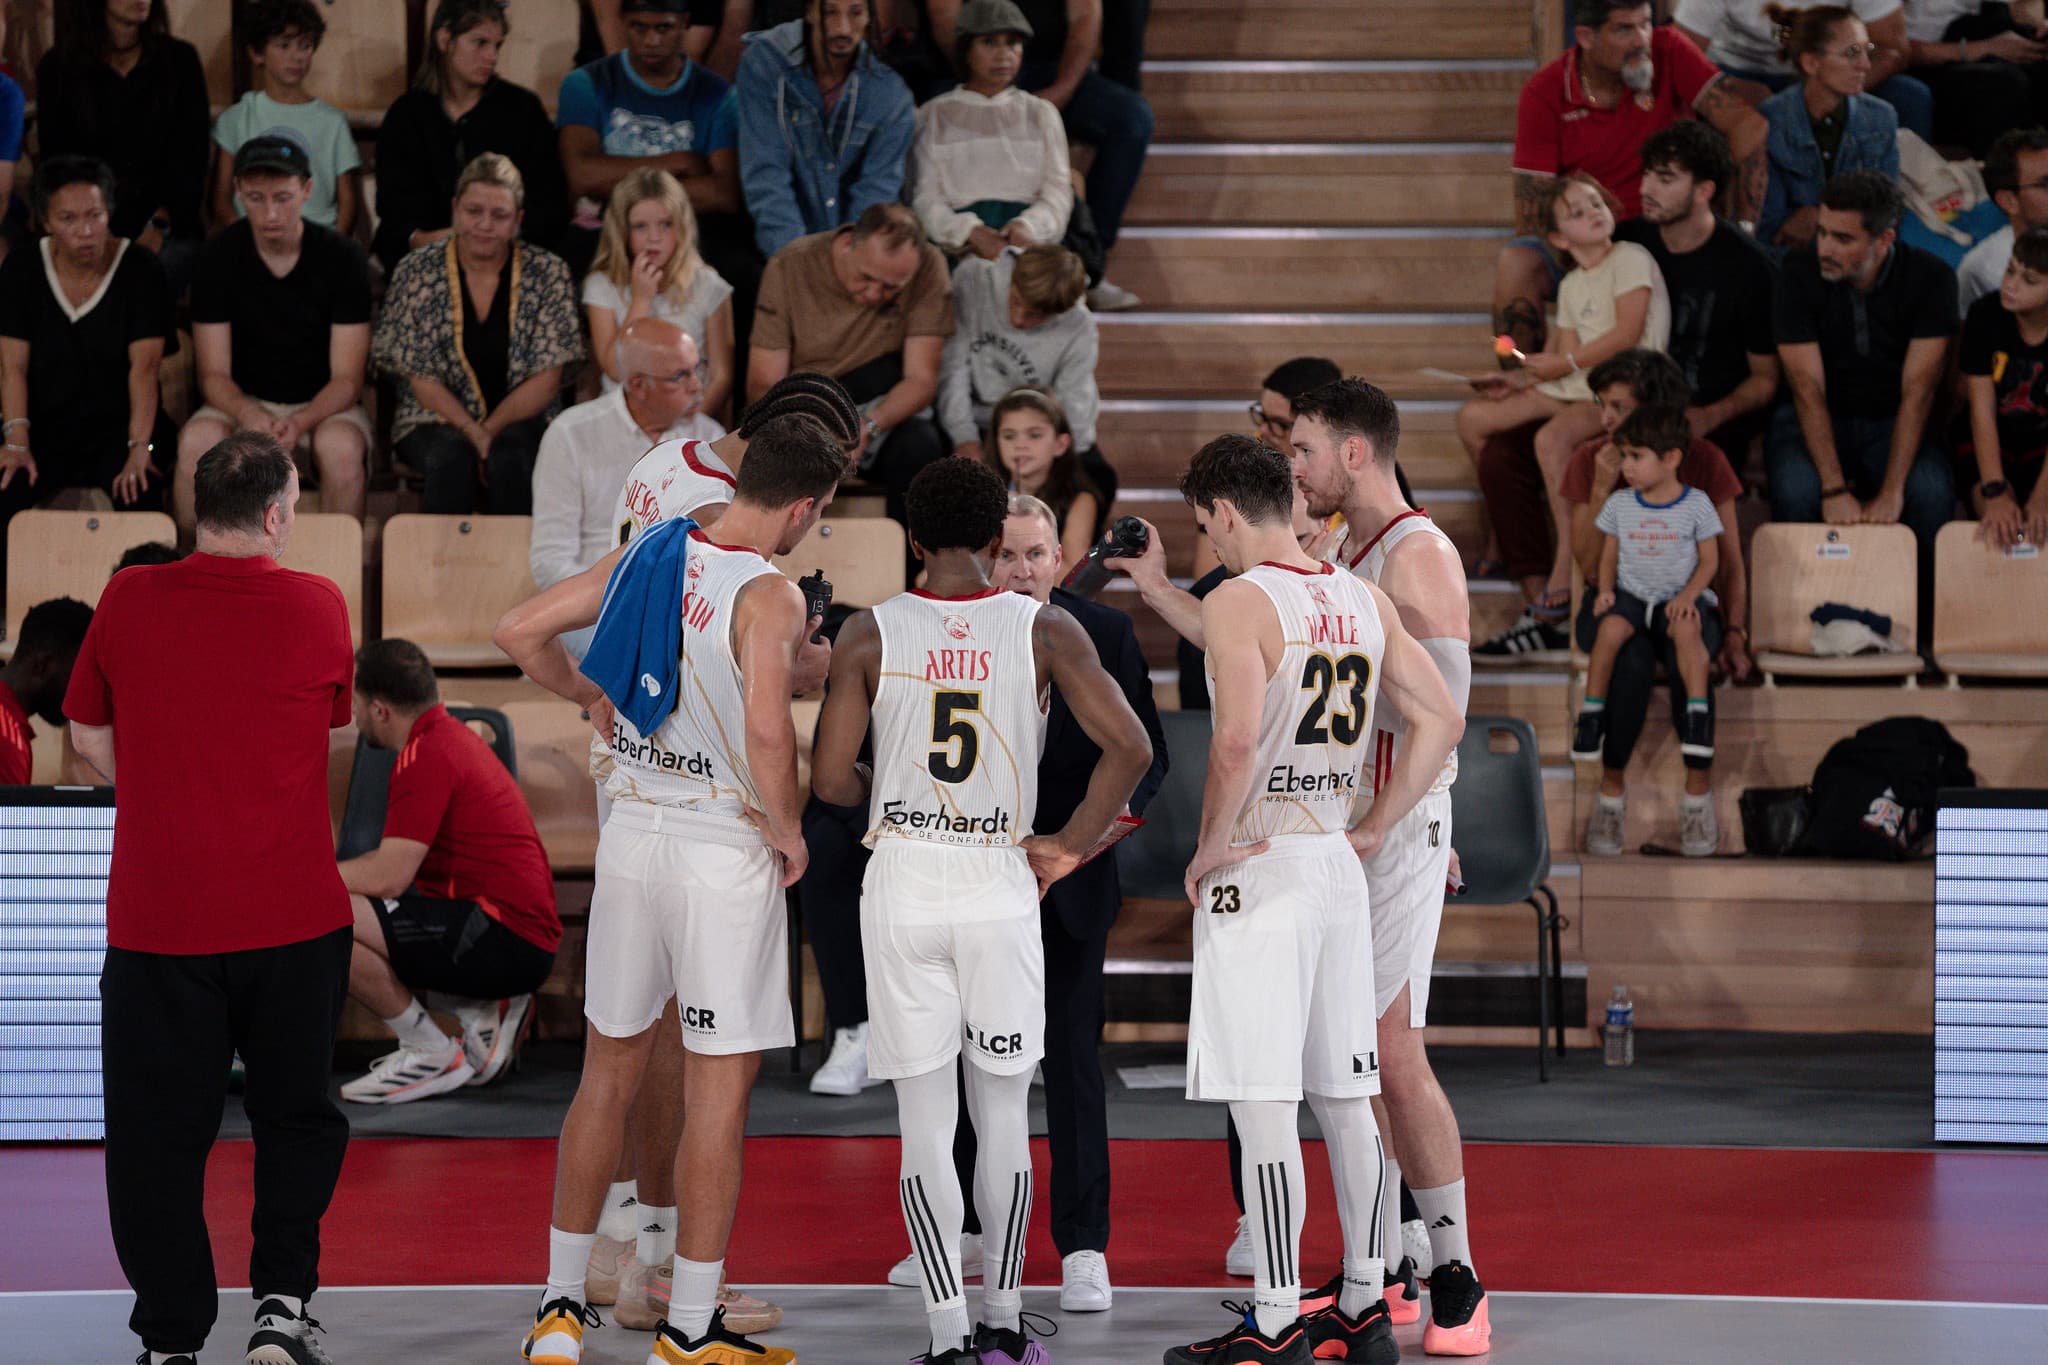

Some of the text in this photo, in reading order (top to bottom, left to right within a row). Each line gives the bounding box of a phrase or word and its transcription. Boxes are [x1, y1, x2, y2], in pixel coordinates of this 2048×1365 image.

[925, 649, 992, 682] ARTIS
[1294, 651, 1373, 748] 23
[927, 689, 983, 785] 5
[918, 830, 934, 840] DE
[939, 834, 1008, 845] CONFIANCE
[1427, 819, 1441, 849] 10
[1210, 884, 1241, 914] 23
[979, 1030, 1023, 1055] LCR
